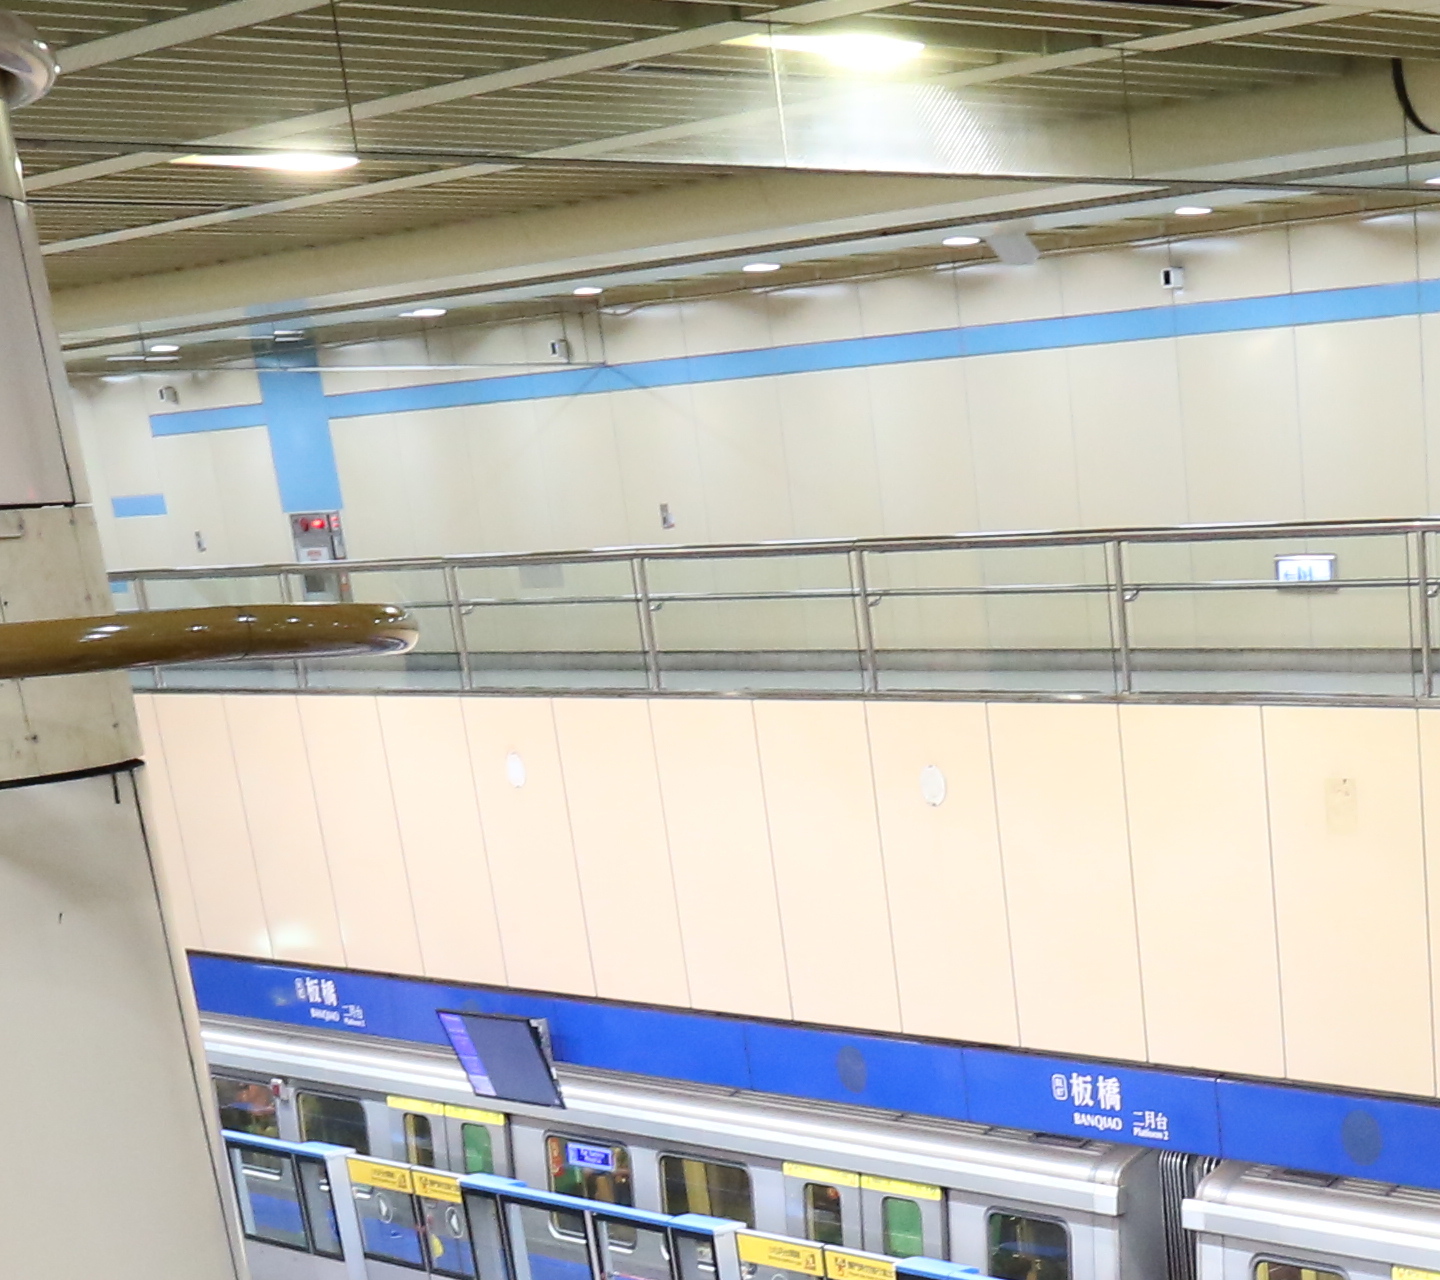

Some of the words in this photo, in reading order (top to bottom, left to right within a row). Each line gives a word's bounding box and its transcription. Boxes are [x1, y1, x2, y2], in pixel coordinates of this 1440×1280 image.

[1069, 1072, 1121, 1111] 板橋
[1072, 1112, 1123, 1131] BANQIAO
[1132, 1110, 1168, 1131] 二月台
